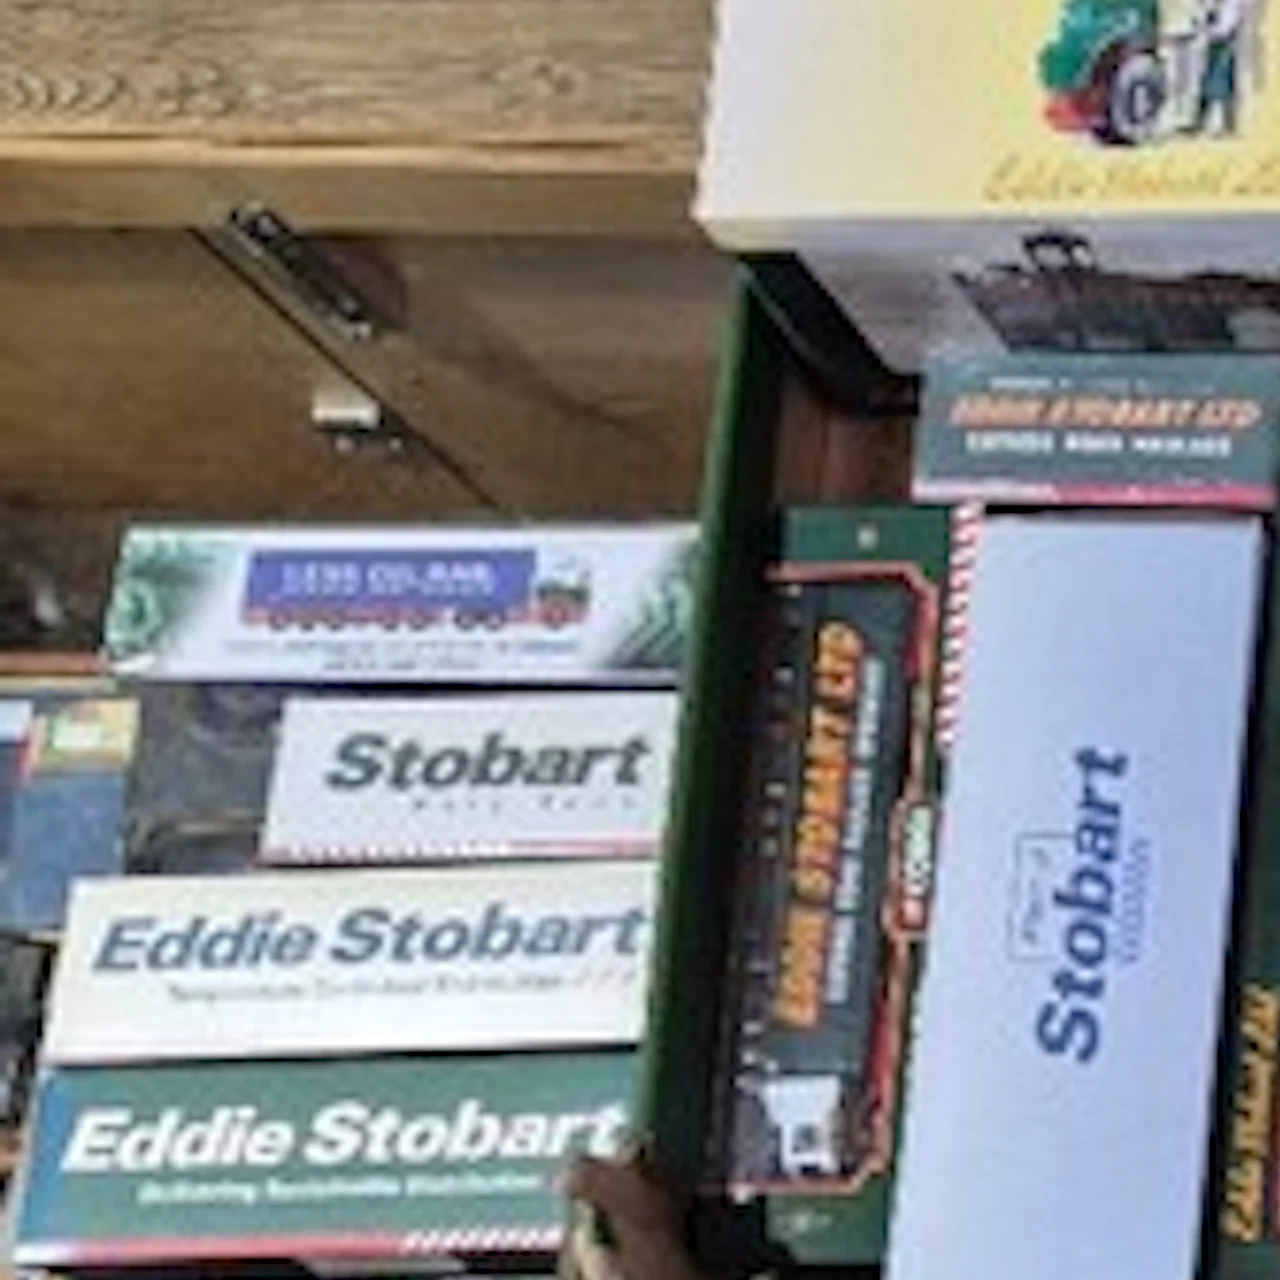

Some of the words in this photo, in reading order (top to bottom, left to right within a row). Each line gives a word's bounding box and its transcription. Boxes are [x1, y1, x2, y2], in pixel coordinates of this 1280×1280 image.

[326, 730, 650, 792] Stobart
[92, 911, 318, 972] Eddie
[331, 906, 650, 964] Stobart
[1031, 745, 1130, 1066] Stobart
[60, 1101, 295, 1173] Eddie
[304, 1098, 630, 1167] Stobart
